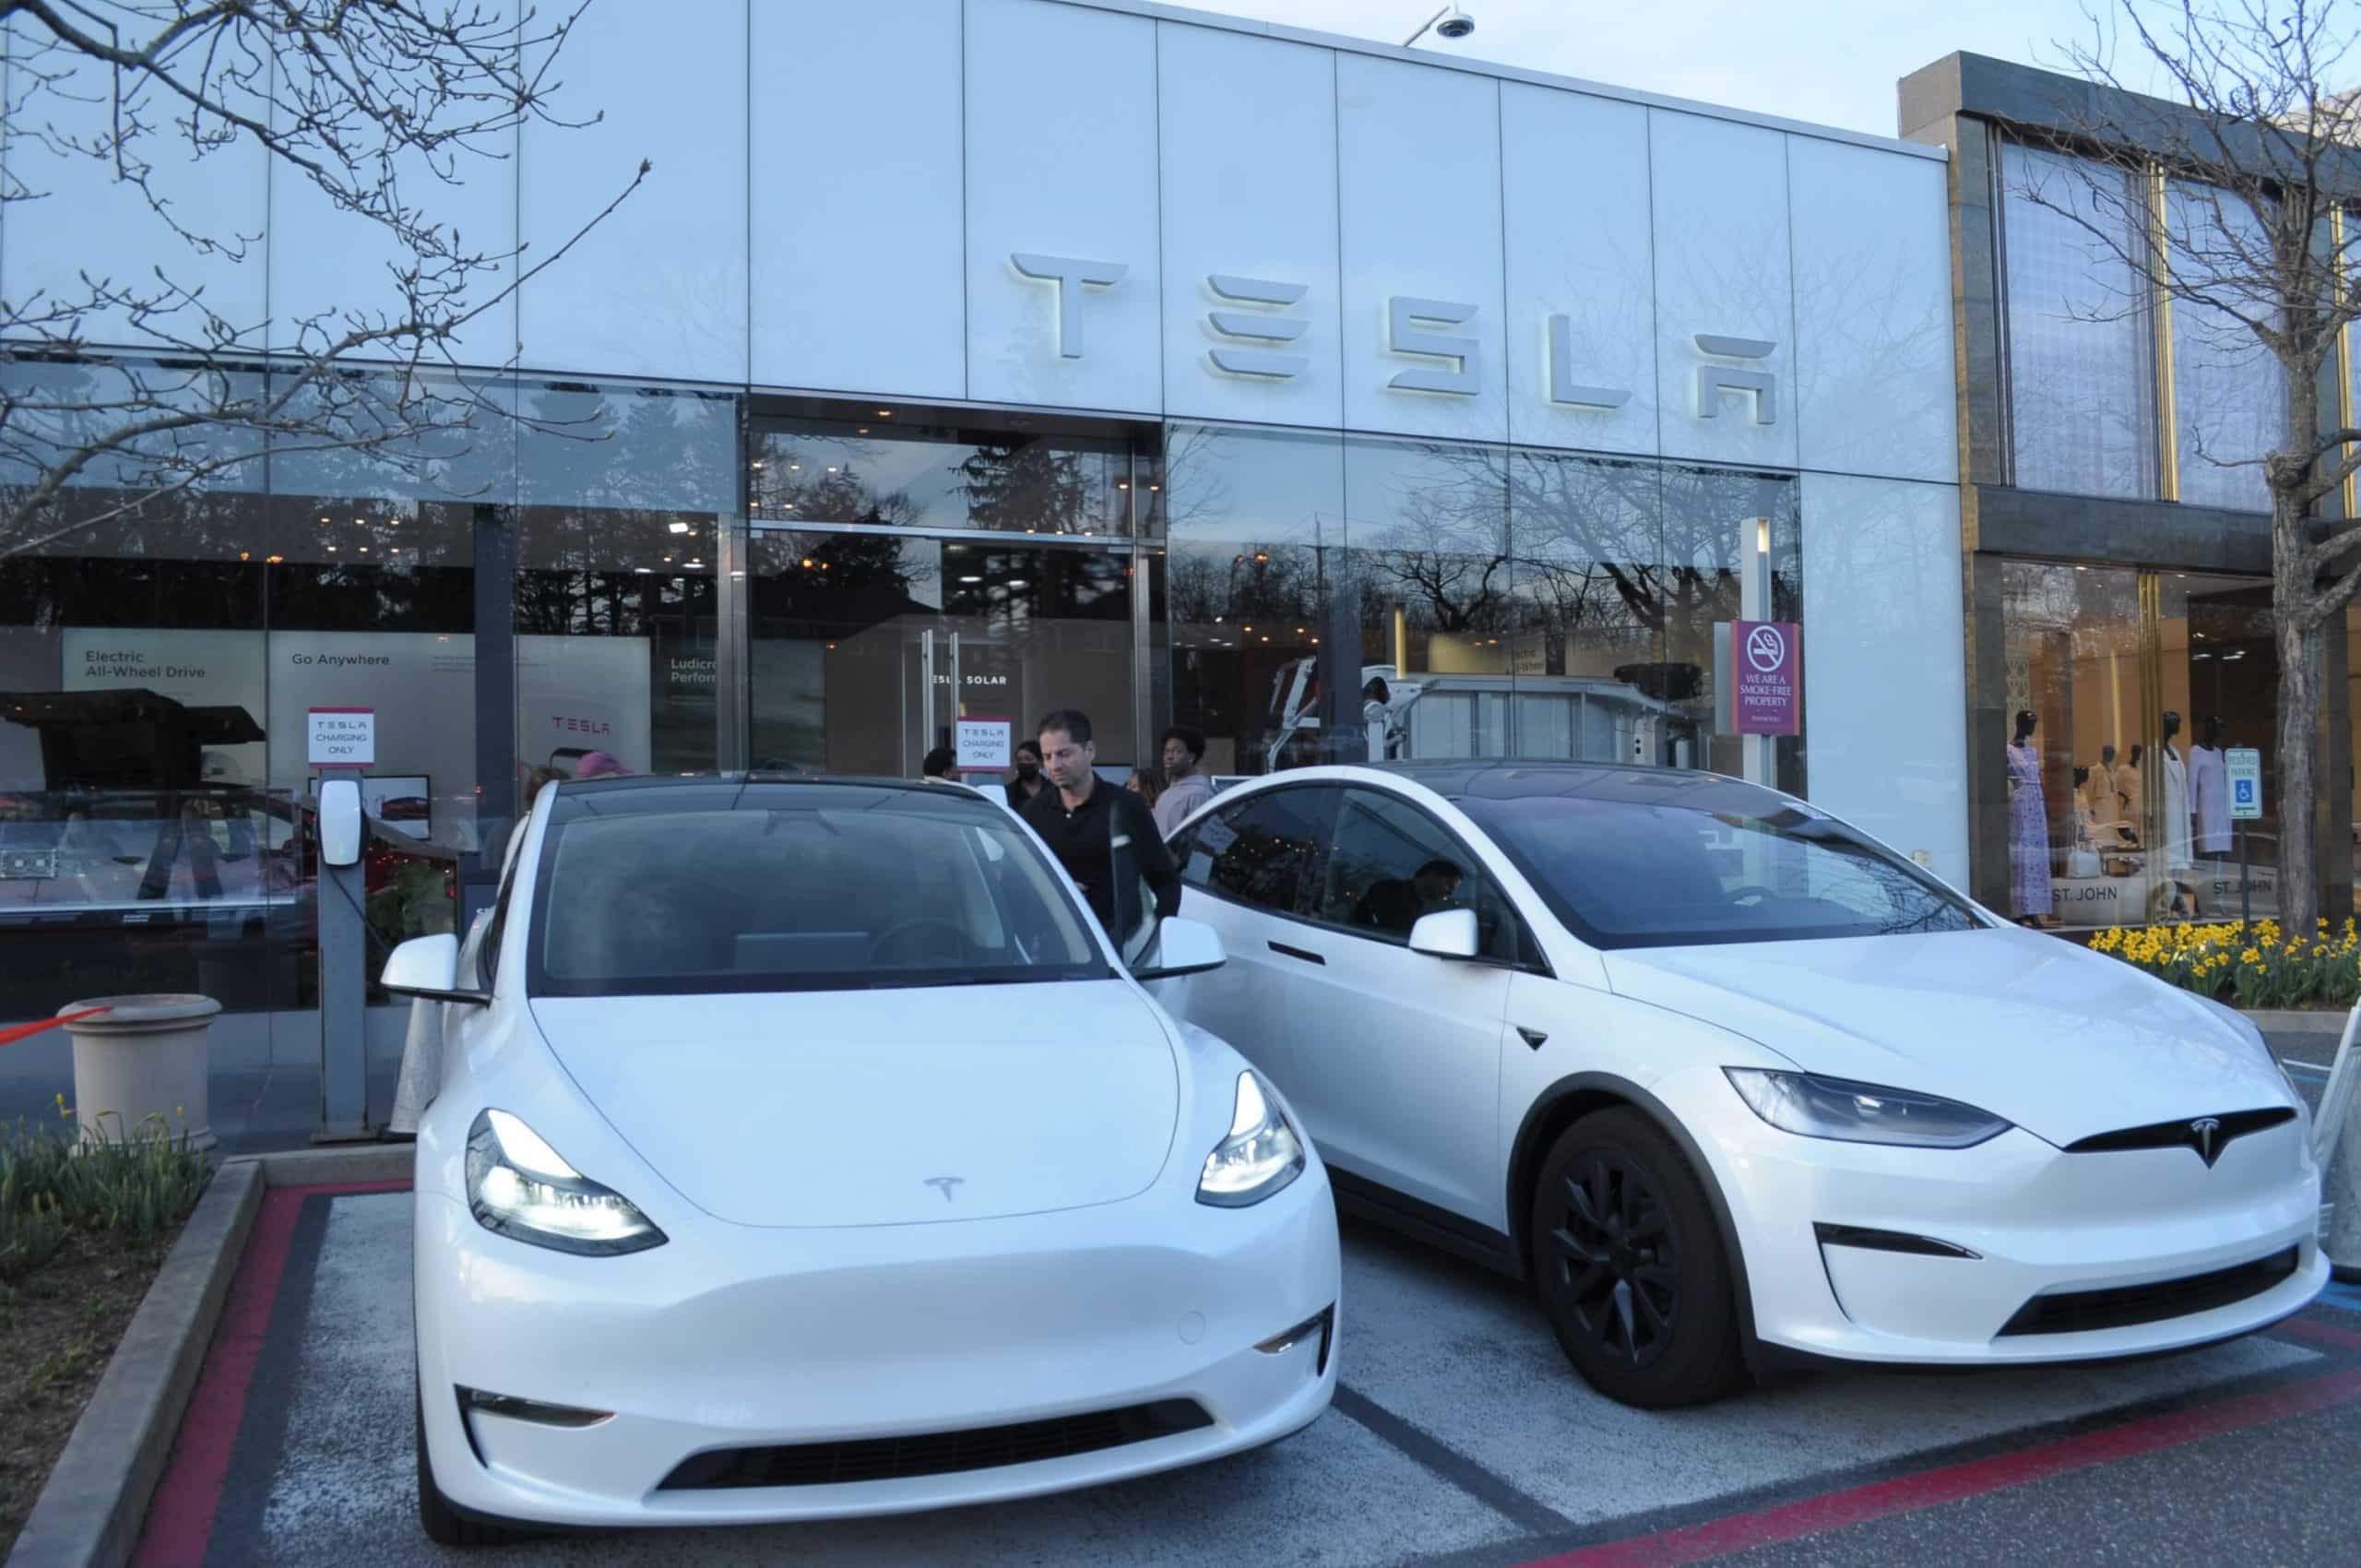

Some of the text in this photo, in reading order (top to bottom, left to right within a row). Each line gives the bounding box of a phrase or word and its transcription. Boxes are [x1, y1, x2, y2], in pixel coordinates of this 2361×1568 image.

[1010, 252, 1775, 425] TESLA
[85, 650, 145, 663] Electric
[291, 653, 390, 667] Go Anywhere
[86, 665, 206, 678] All-Wheel Drive
[966, 675, 1007, 685] SOLAR
[1745, 673, 1786, 685] WE ARE A
[1739, 684, 1792, 696] SMOKE-FREE
[1744, 696, 1787, 707] PROPERTY
[552, 716, 611, 737] TESLA
[315, 733, 367, 742] CHARGING
[2076, 885, 2118, 901] JOHN
[2236, 879, 2272, 894] JHN
